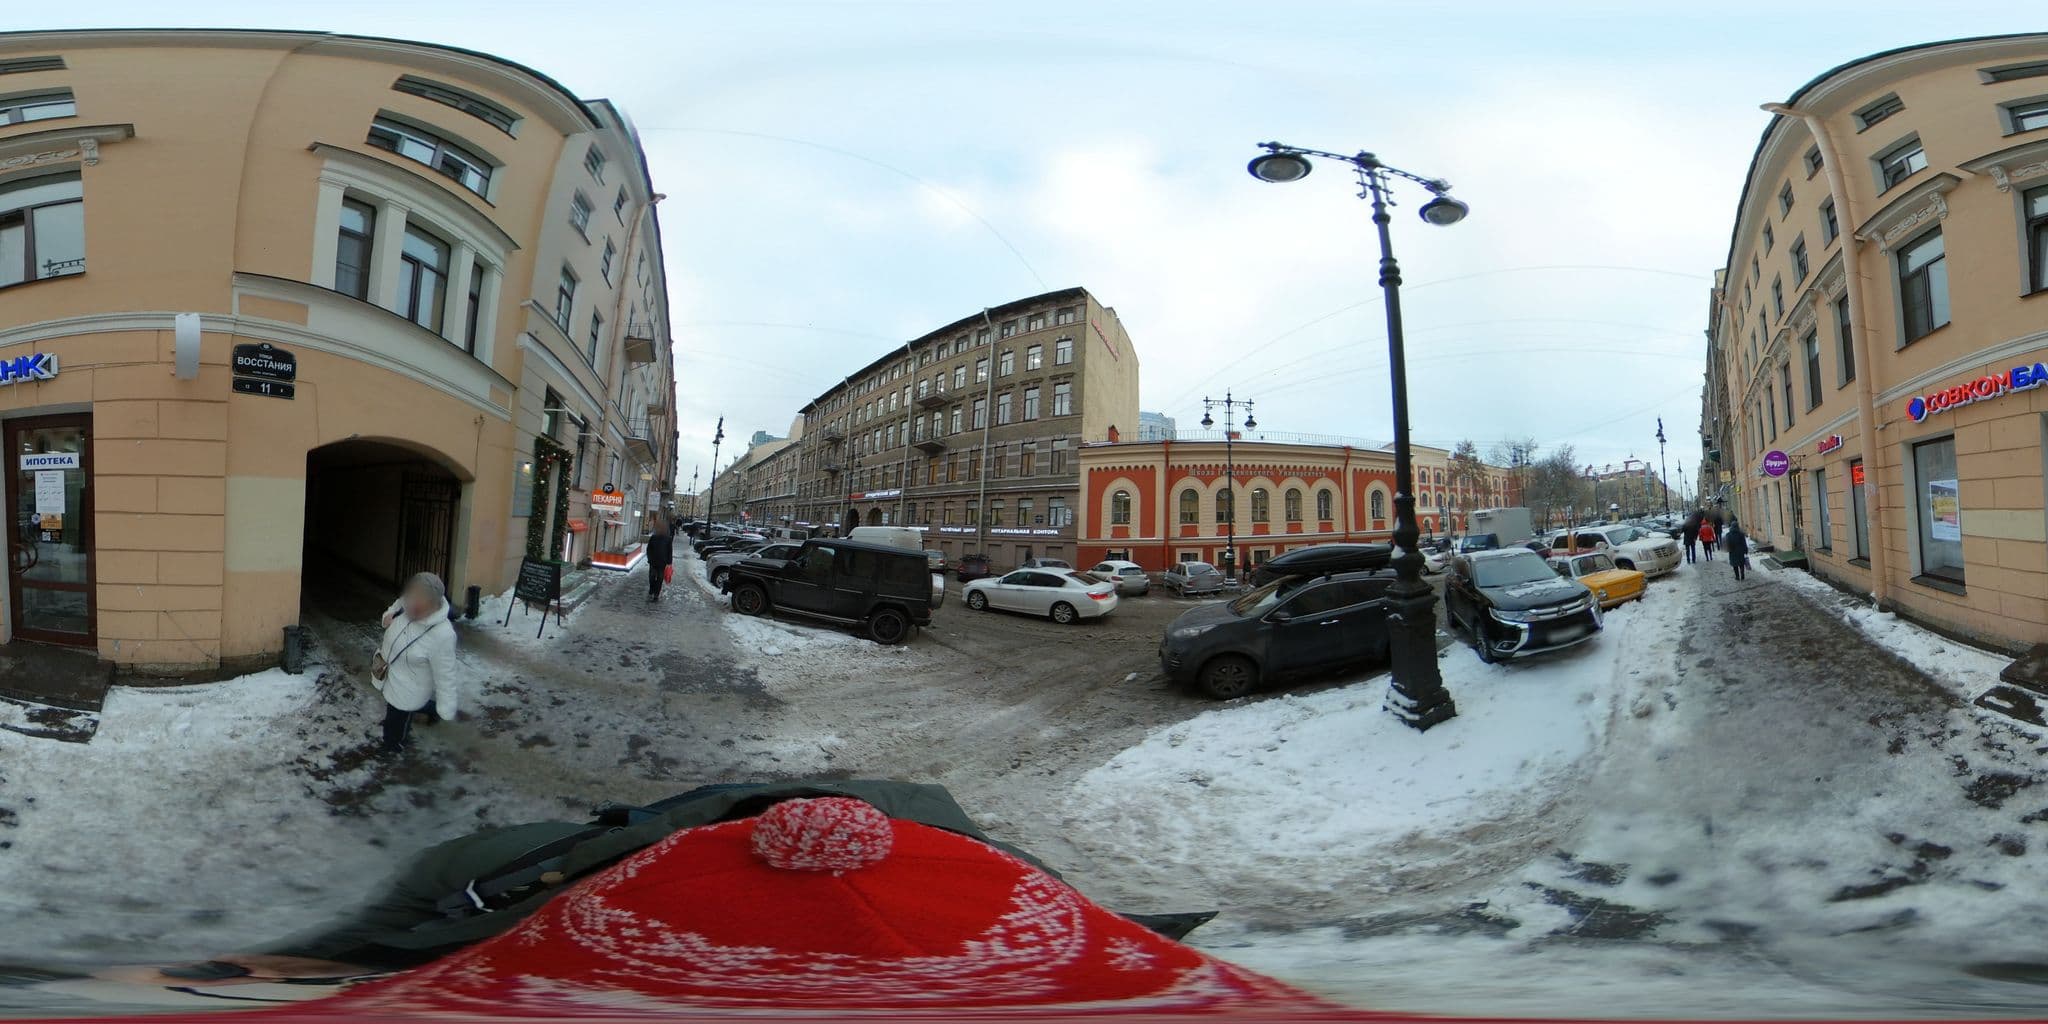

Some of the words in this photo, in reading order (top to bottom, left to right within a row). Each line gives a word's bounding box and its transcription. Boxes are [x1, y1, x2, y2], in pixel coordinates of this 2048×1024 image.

[0, 352, 50, 382] НК
[237, 356, 293, 373] ВОССТАНИЯ
[260, 383, 271, 394] 11
[26, 456, 74, 466] ИПОТЕКА
[592, 494, 622, 505] ПЕКАРНЯ
